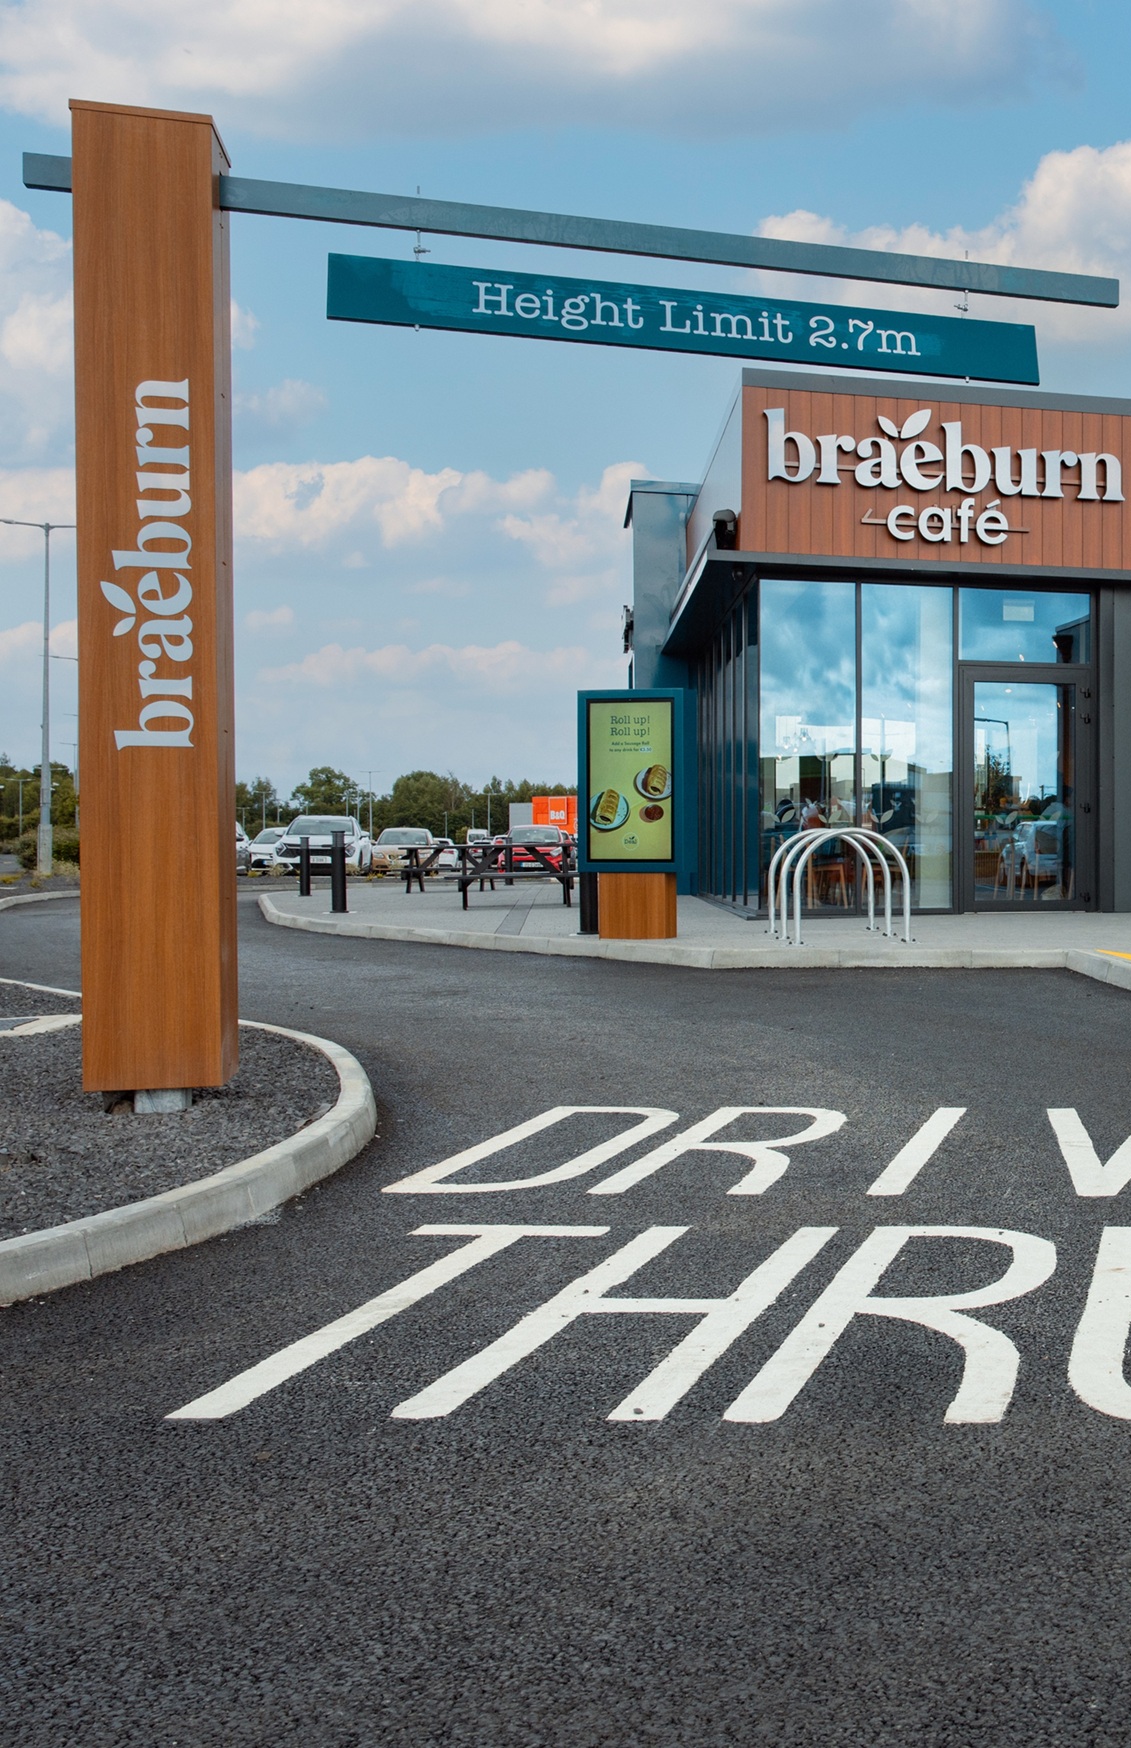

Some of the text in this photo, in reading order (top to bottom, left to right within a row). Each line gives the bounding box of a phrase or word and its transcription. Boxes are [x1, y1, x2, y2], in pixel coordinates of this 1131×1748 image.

[471, 281, 921, 356] Height Limit 2.7m
[763, 408, 1126, 501] braeburn
[886, 498, 1009, 545] café
[113, 378, 195, 751] braeburn
[610, 715, 650, 726] Roll up!
[610, 727, 650, 738] Roll up!
